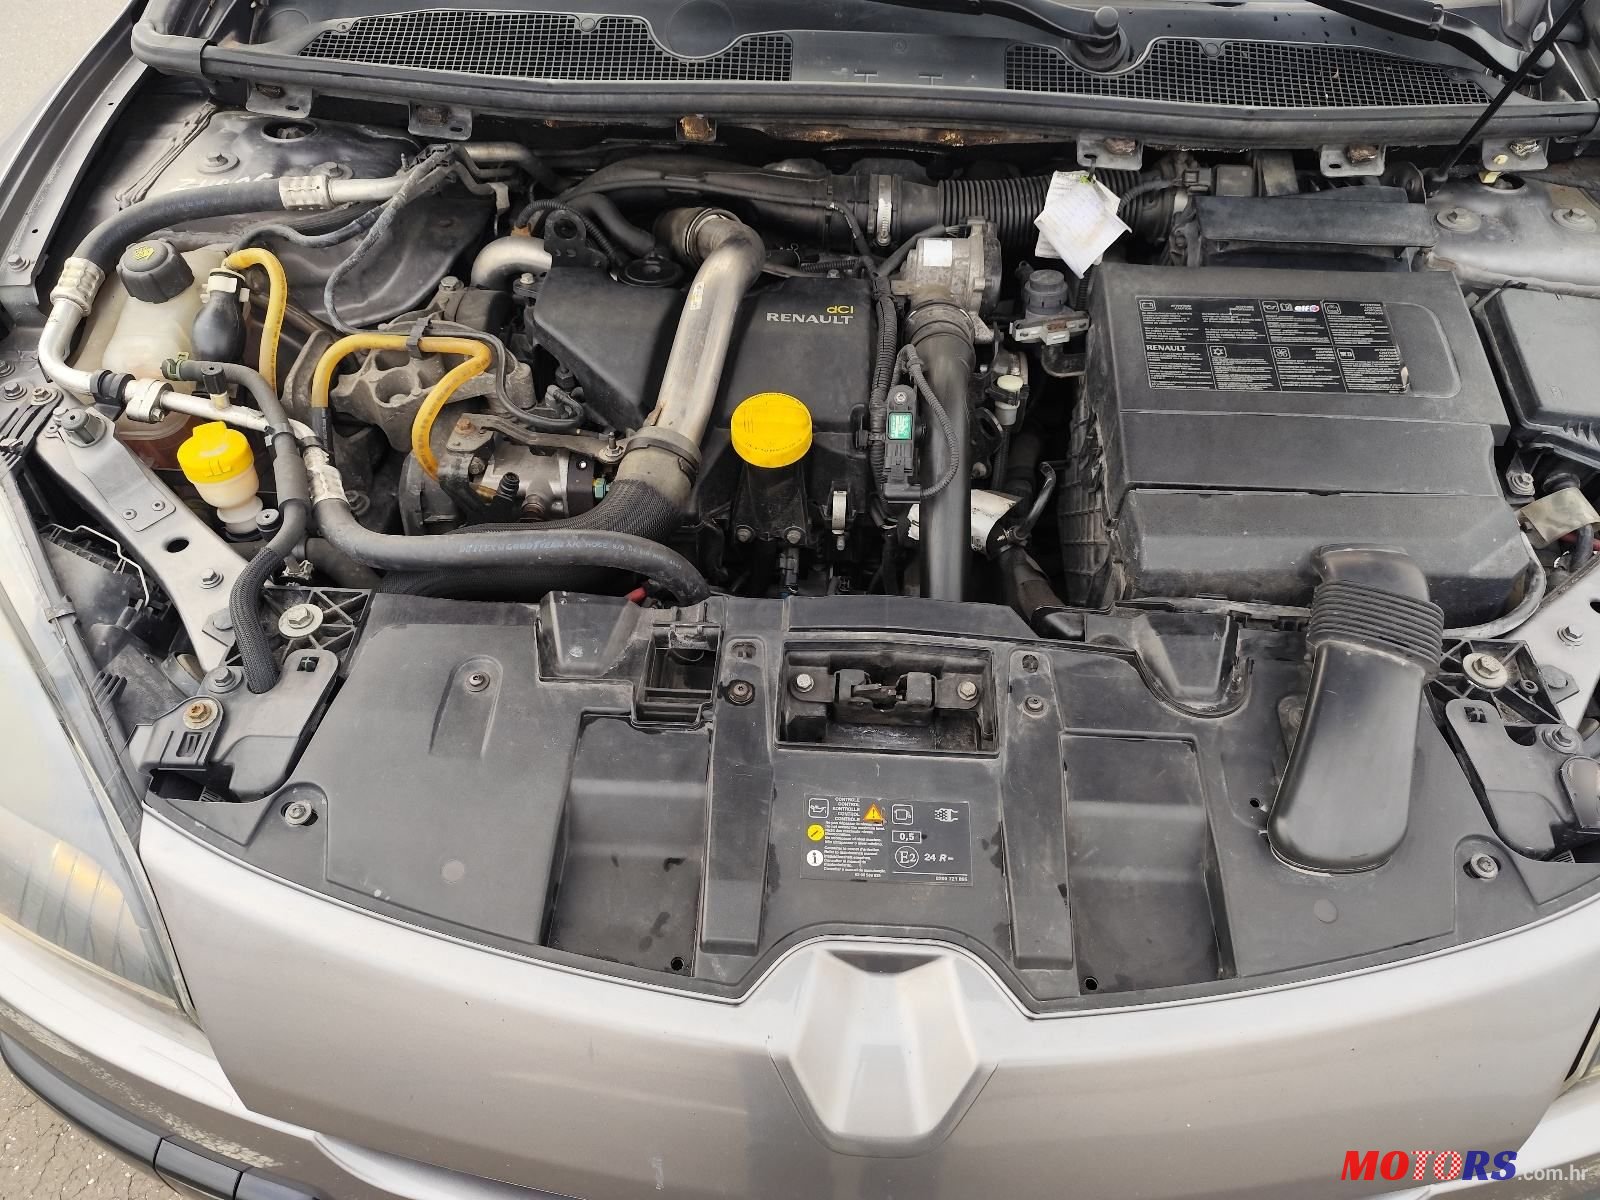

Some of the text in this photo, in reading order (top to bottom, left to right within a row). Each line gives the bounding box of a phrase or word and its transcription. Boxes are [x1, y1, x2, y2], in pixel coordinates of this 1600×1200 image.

[766, 312, 853, 324] RENAULT
[1145, 344, 1186, 352] RENAULT
[899, 832, 915, 842] 0,5
[899, 850, 917, 864] E2
[924, 853, 937, 862] 24
